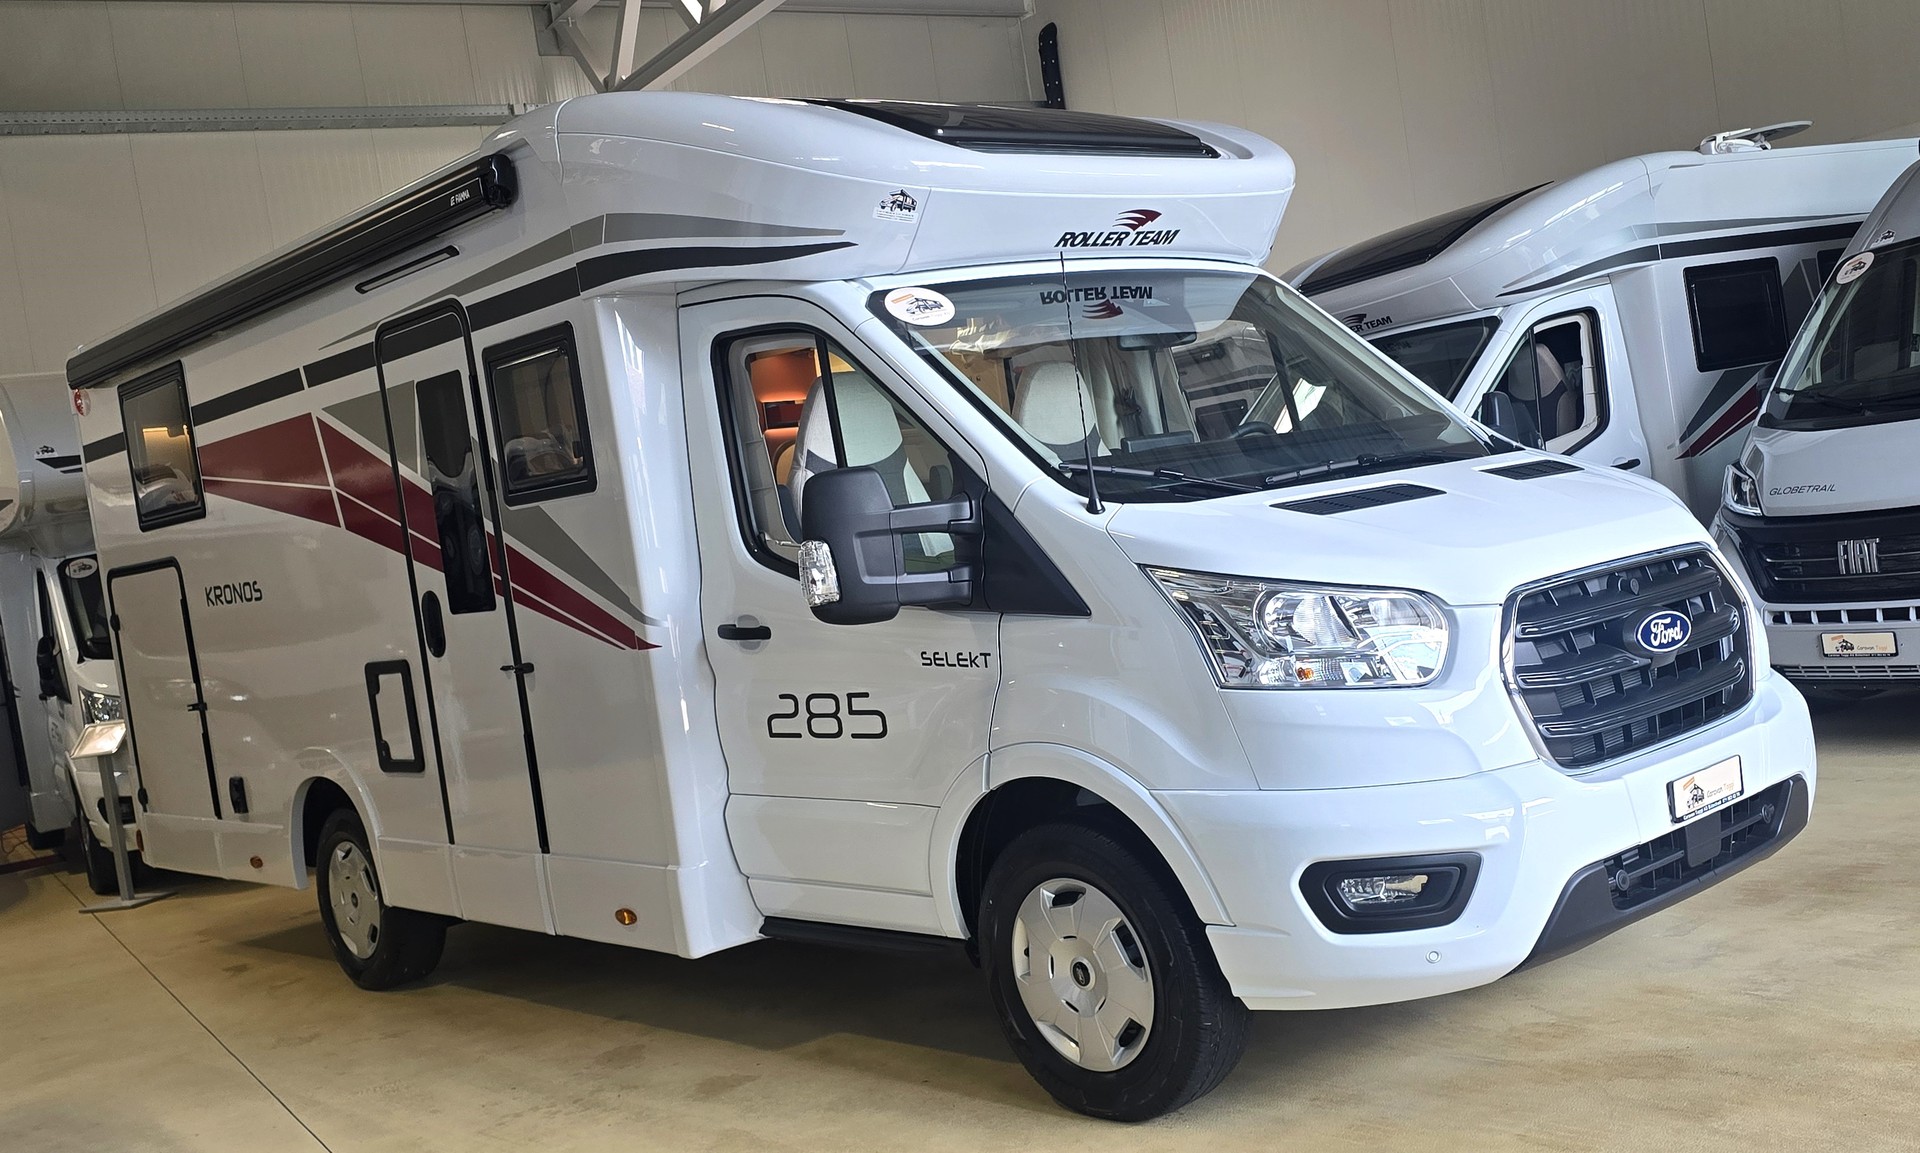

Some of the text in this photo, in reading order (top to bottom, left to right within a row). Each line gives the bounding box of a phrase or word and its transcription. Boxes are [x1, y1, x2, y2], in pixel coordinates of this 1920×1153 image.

[1054, 229, 1181, 248] ROLLER TEAM
[1364, 316, 1393, 329] TEAM
[1769, 484, 1836, 496] GLOBETRAIL
[1836, 537, 1880, 575] FIAT
[204, 580, 263, 607] KRONOS
[1650, 617, 1683, 646] Ford
[766, 691, 888, 740] 285
